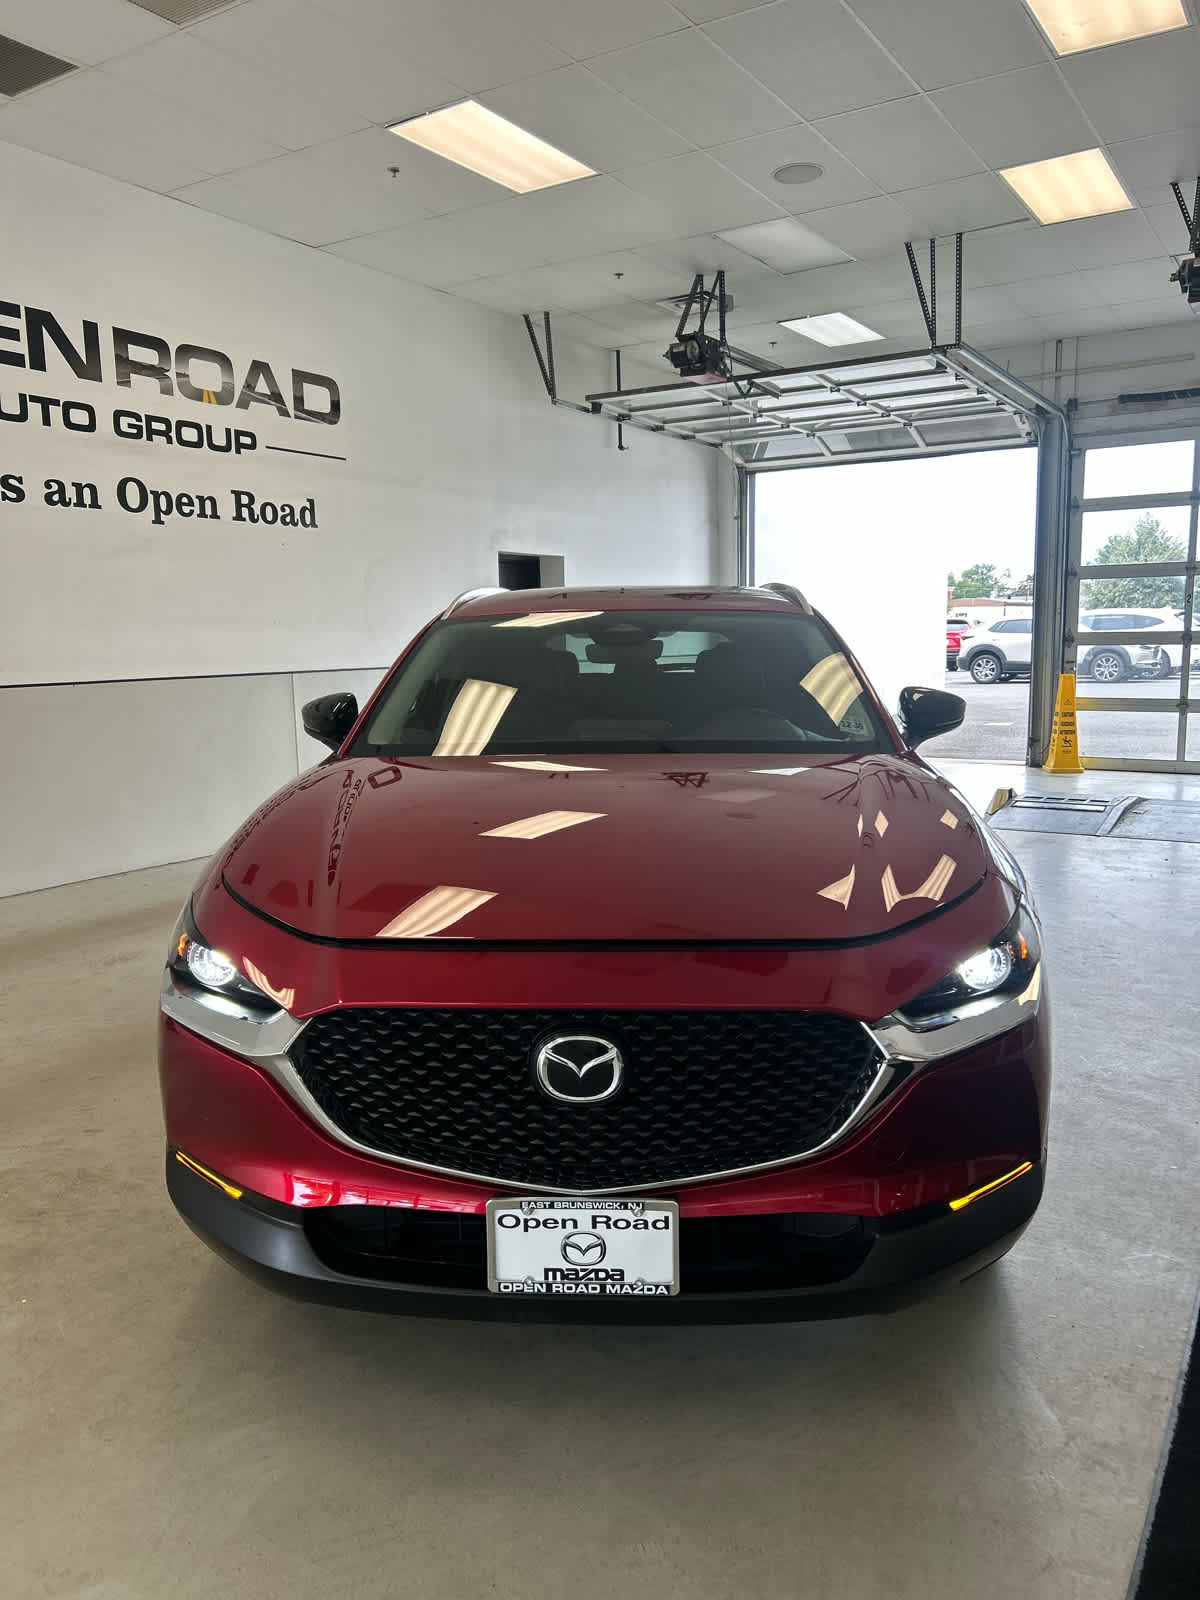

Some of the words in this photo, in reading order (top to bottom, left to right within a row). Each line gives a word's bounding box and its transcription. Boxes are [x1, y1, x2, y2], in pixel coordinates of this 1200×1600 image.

[112, 326, 341, 426] ROAD
[113, 409, 257, 455] GROUP
[43, 478, 102, 510] an
[116, 476, 221, 525] Open
[231, 489, 319, 529] Road
[521, 1201, 550, 1209] EAST
[497, 1213, 579, 1232] Open
[591, 1215, 671, 1230] Road
[500, 1282, 547, 1293] OPEN
[552, 1283, 600, 1294] ROAD
[605, 1284, 669, 1295] MAZDA
